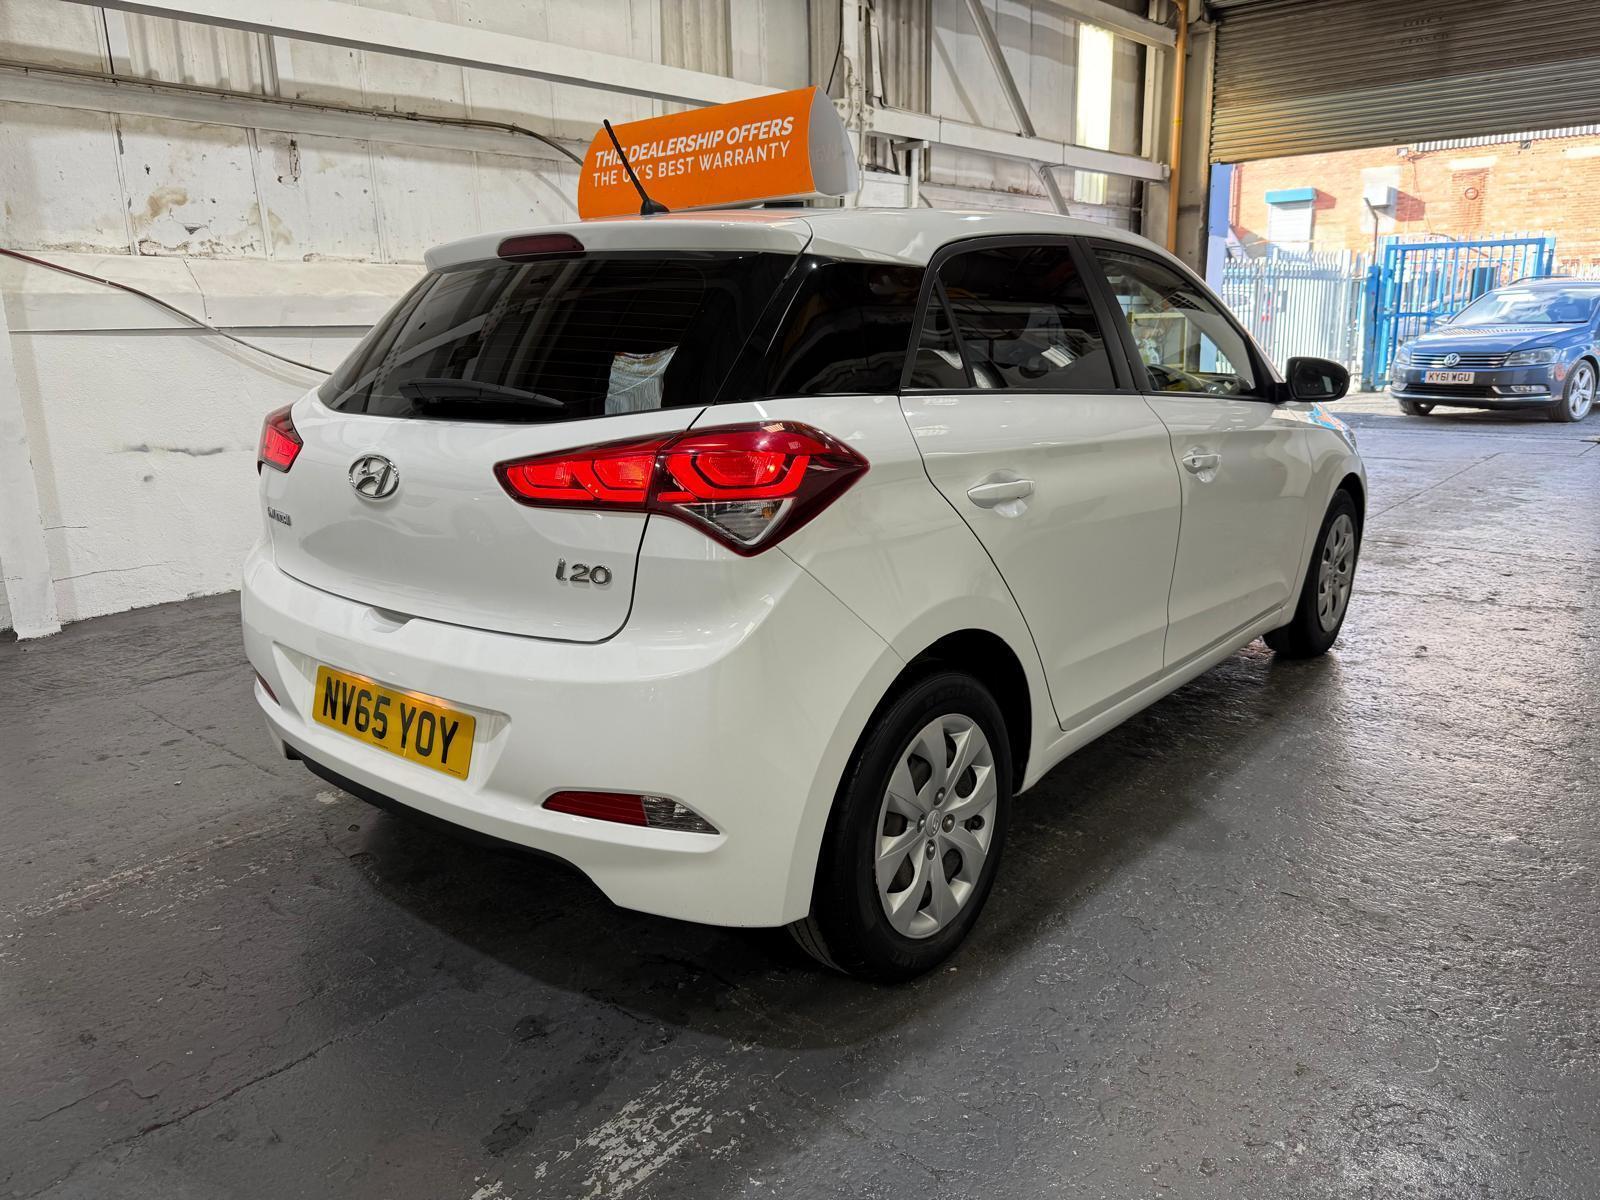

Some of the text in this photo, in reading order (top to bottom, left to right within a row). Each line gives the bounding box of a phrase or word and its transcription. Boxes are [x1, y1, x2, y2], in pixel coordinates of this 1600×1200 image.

[629, 129, 724, 163] DEALERSHIP
[726, 116, 794, 145] OFFERS
[592, 170, 618, 188] THE
[658, 157, 694, 178] BEST
[698, 140, 791, 171] WARRANTY
[1428, 372, 1470, 382] KY61 WGU
[323, 676, 459, 764] NV65 YOY
